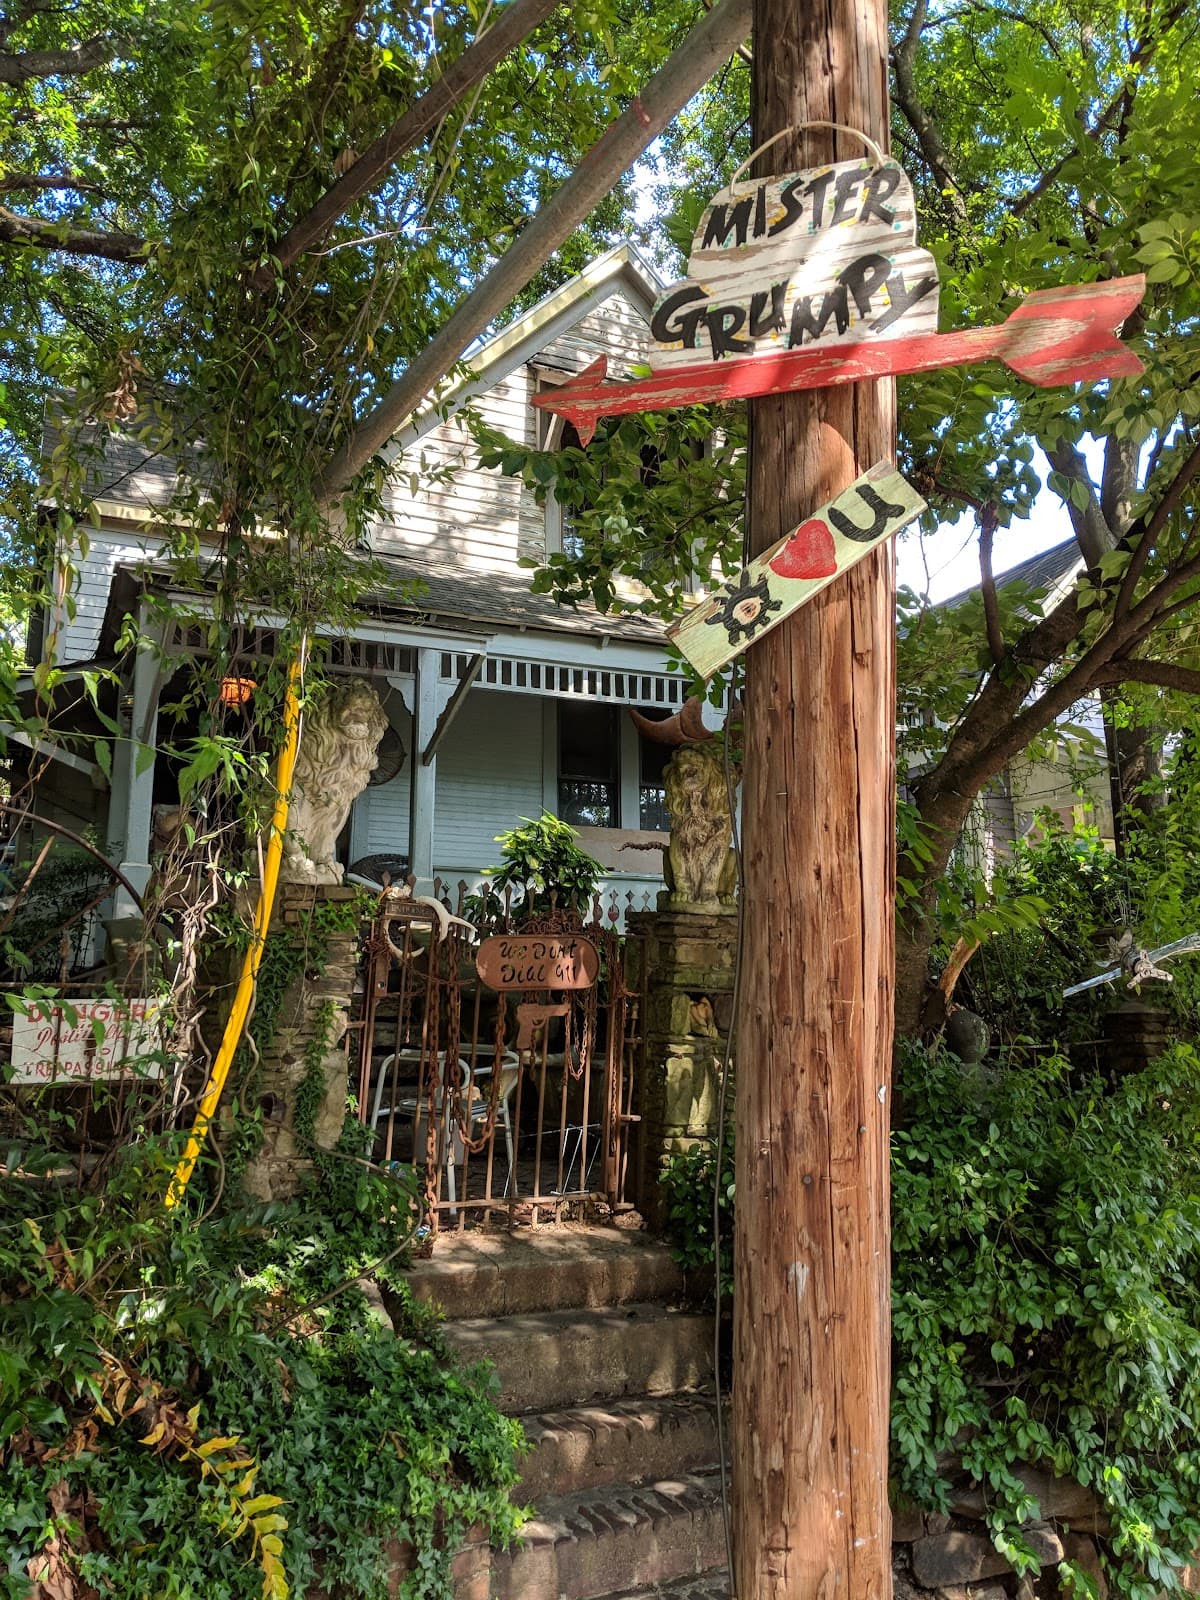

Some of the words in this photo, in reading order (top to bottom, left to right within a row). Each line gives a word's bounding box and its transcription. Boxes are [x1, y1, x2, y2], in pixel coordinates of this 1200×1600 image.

[701, 167, 901, 249] MISTER
[651, 254, 940, 361] GRUMPY
[500, 941, 528, 959] We
[501, 964, 545, 983] Dial
[556, 964, 577, 983] 911
